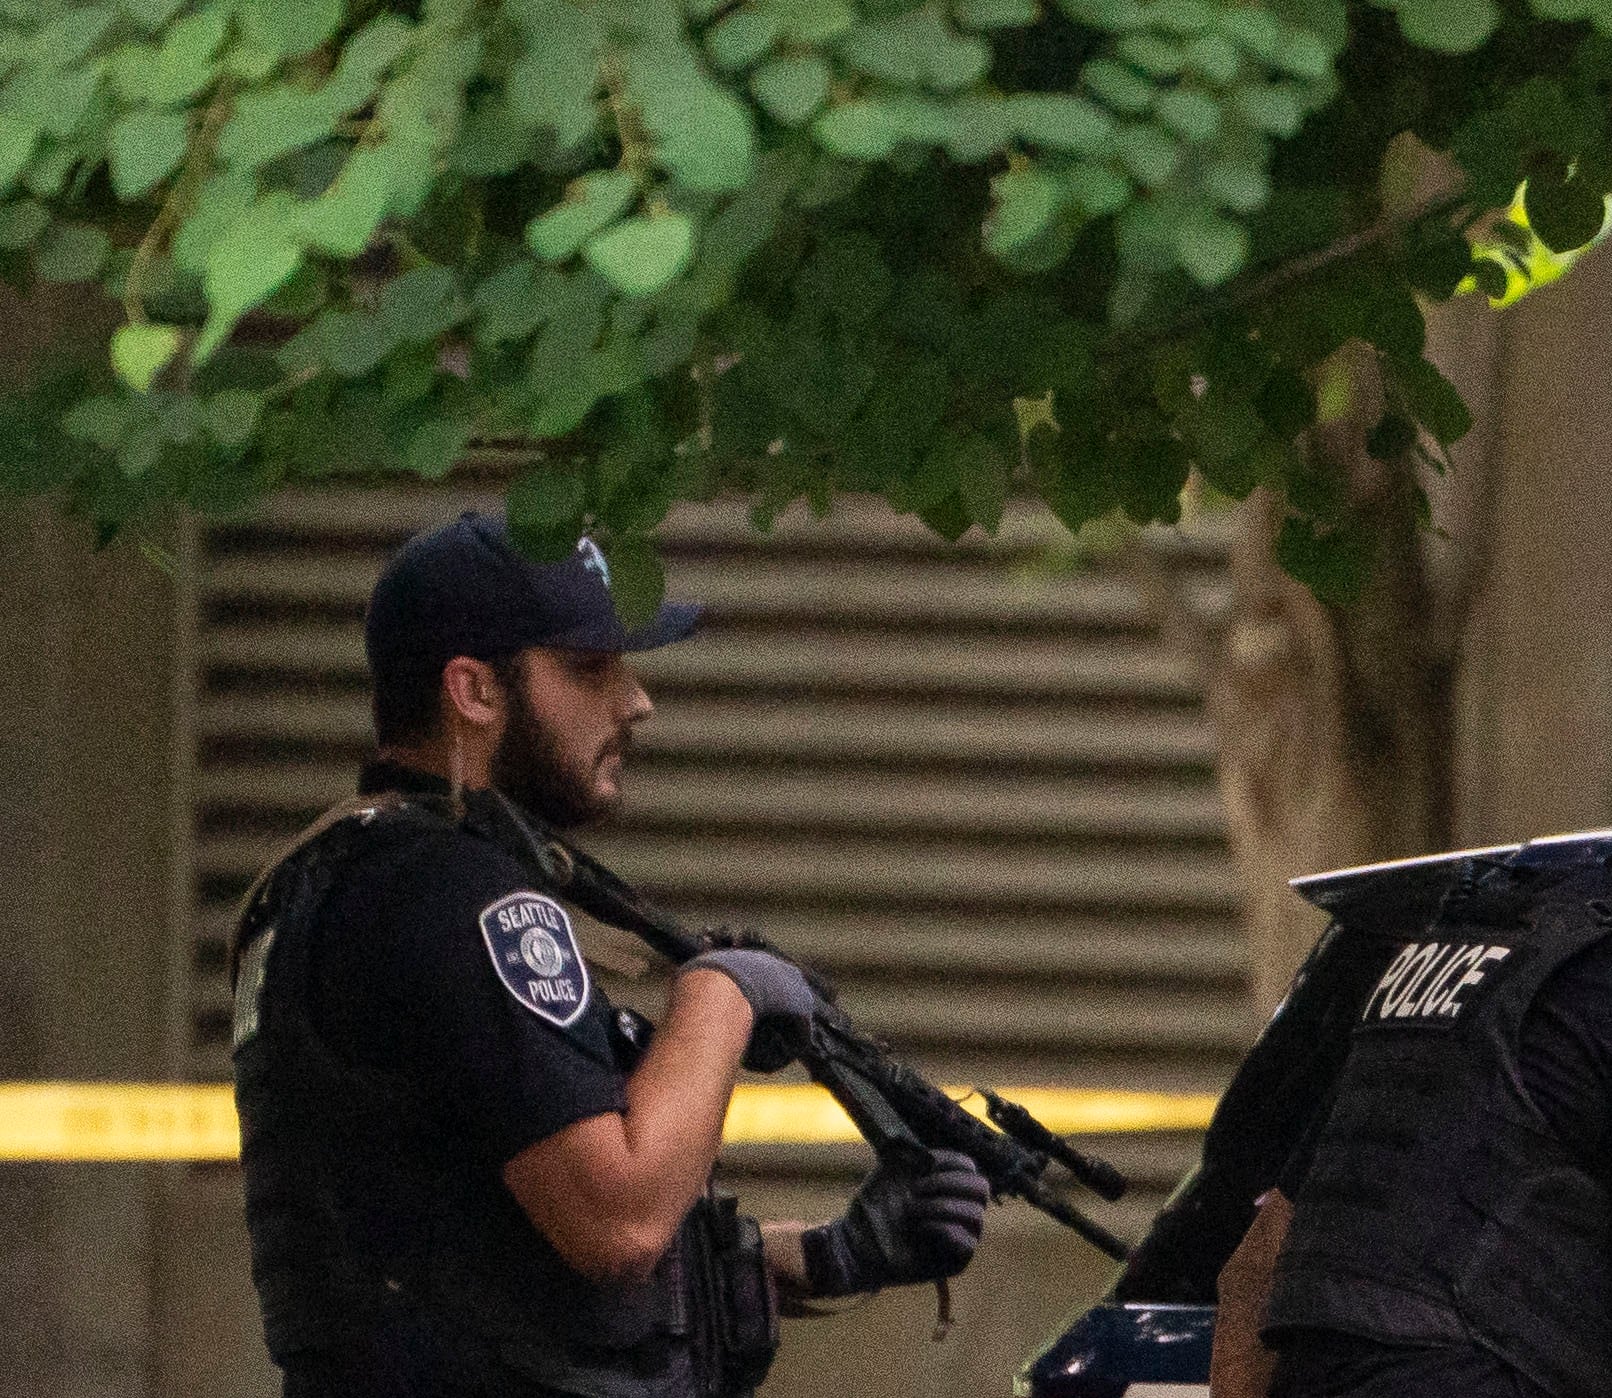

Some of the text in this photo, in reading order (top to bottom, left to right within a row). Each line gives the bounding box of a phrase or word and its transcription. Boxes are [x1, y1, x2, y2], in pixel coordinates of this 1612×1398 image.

[498, 903, 560, 932] SEATTLE
[528, 979, 577, 1003] POLICE
[1362, 943, 1511, 1021] POLICE
